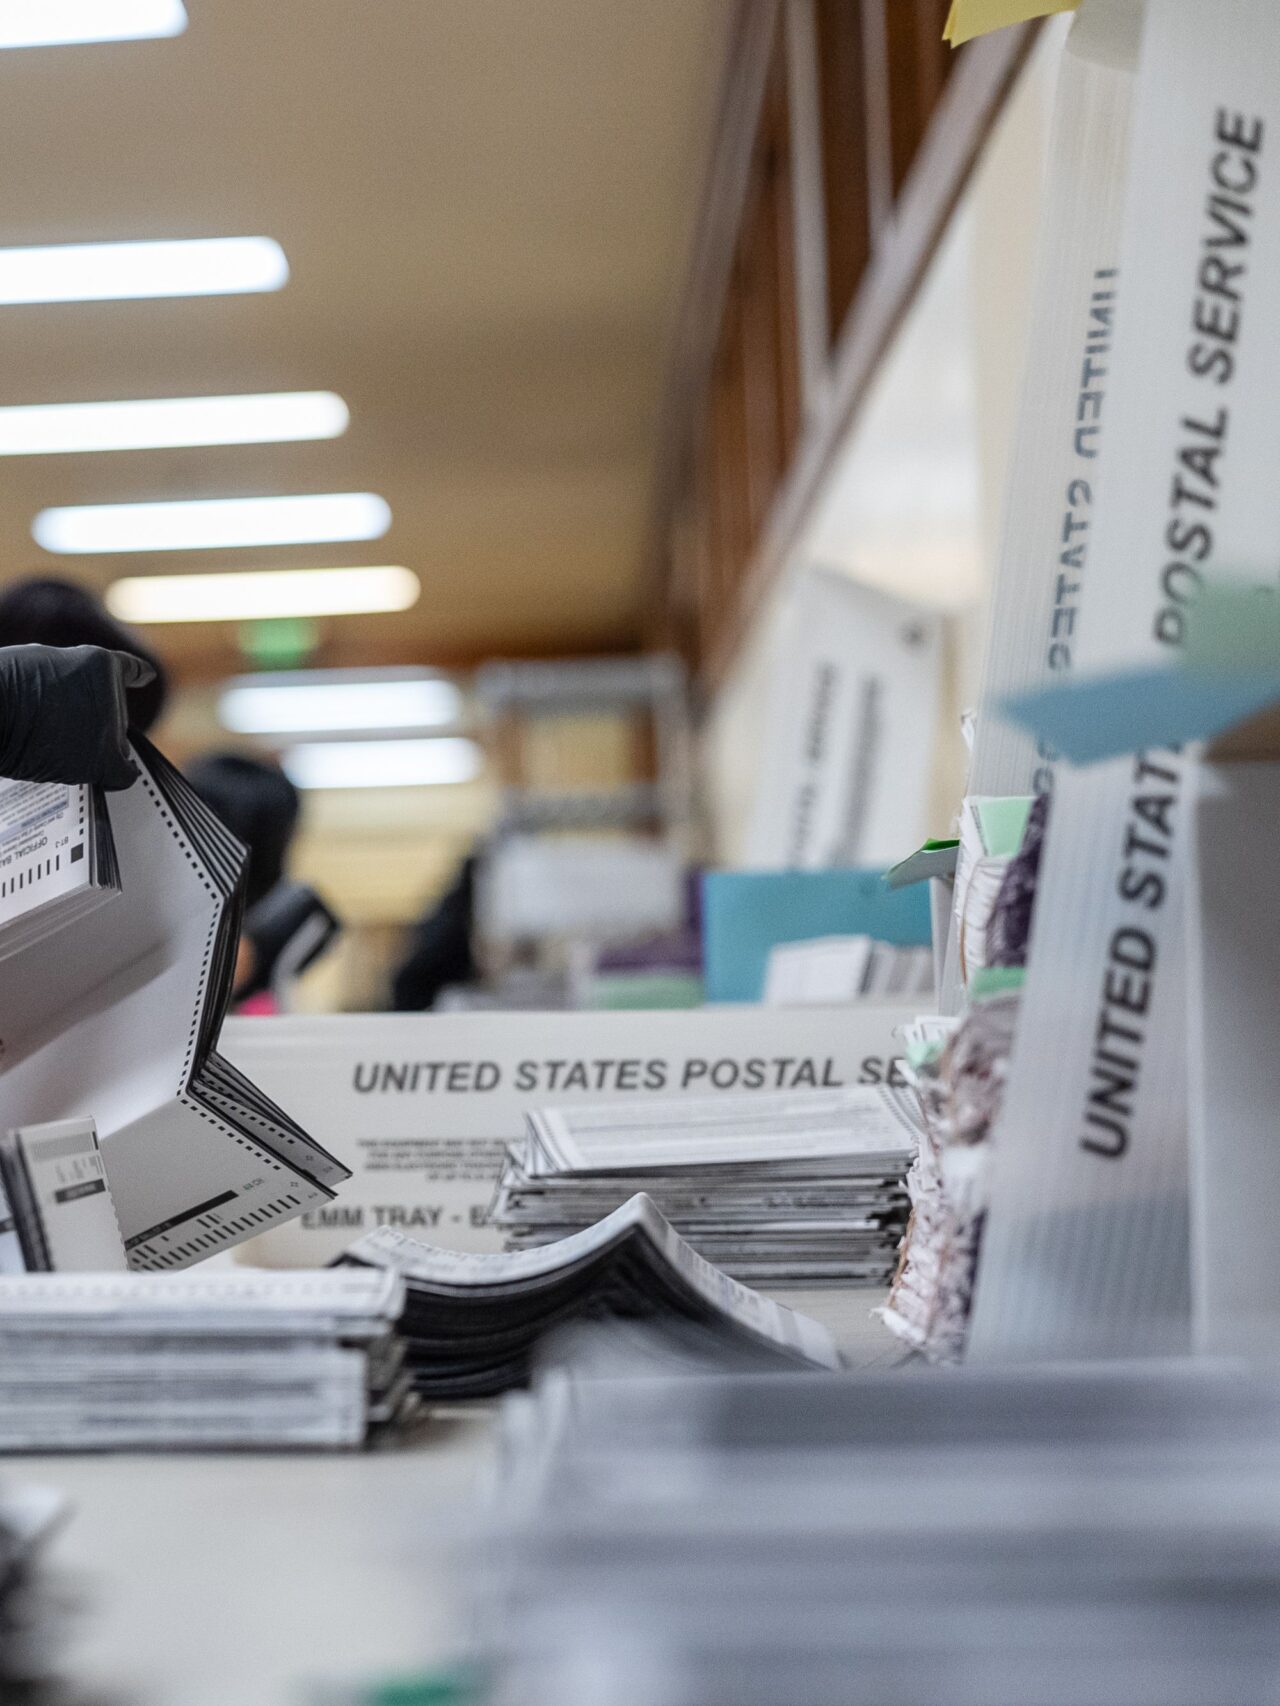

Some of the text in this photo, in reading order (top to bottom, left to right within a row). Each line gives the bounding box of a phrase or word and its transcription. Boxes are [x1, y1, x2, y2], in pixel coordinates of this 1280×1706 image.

[1078, 106, 1266, 1161] UNITED STAT POSTAL SERVICE
[14, 836, 48, 859] OFFICIAL
[353, 1060, 501, 1094] UNITED
[515, 1058, 668, 1092] STATES
[681, 1056, 844, 1090] POSTAL
[372, 1204, 443, 1228] TRAY
